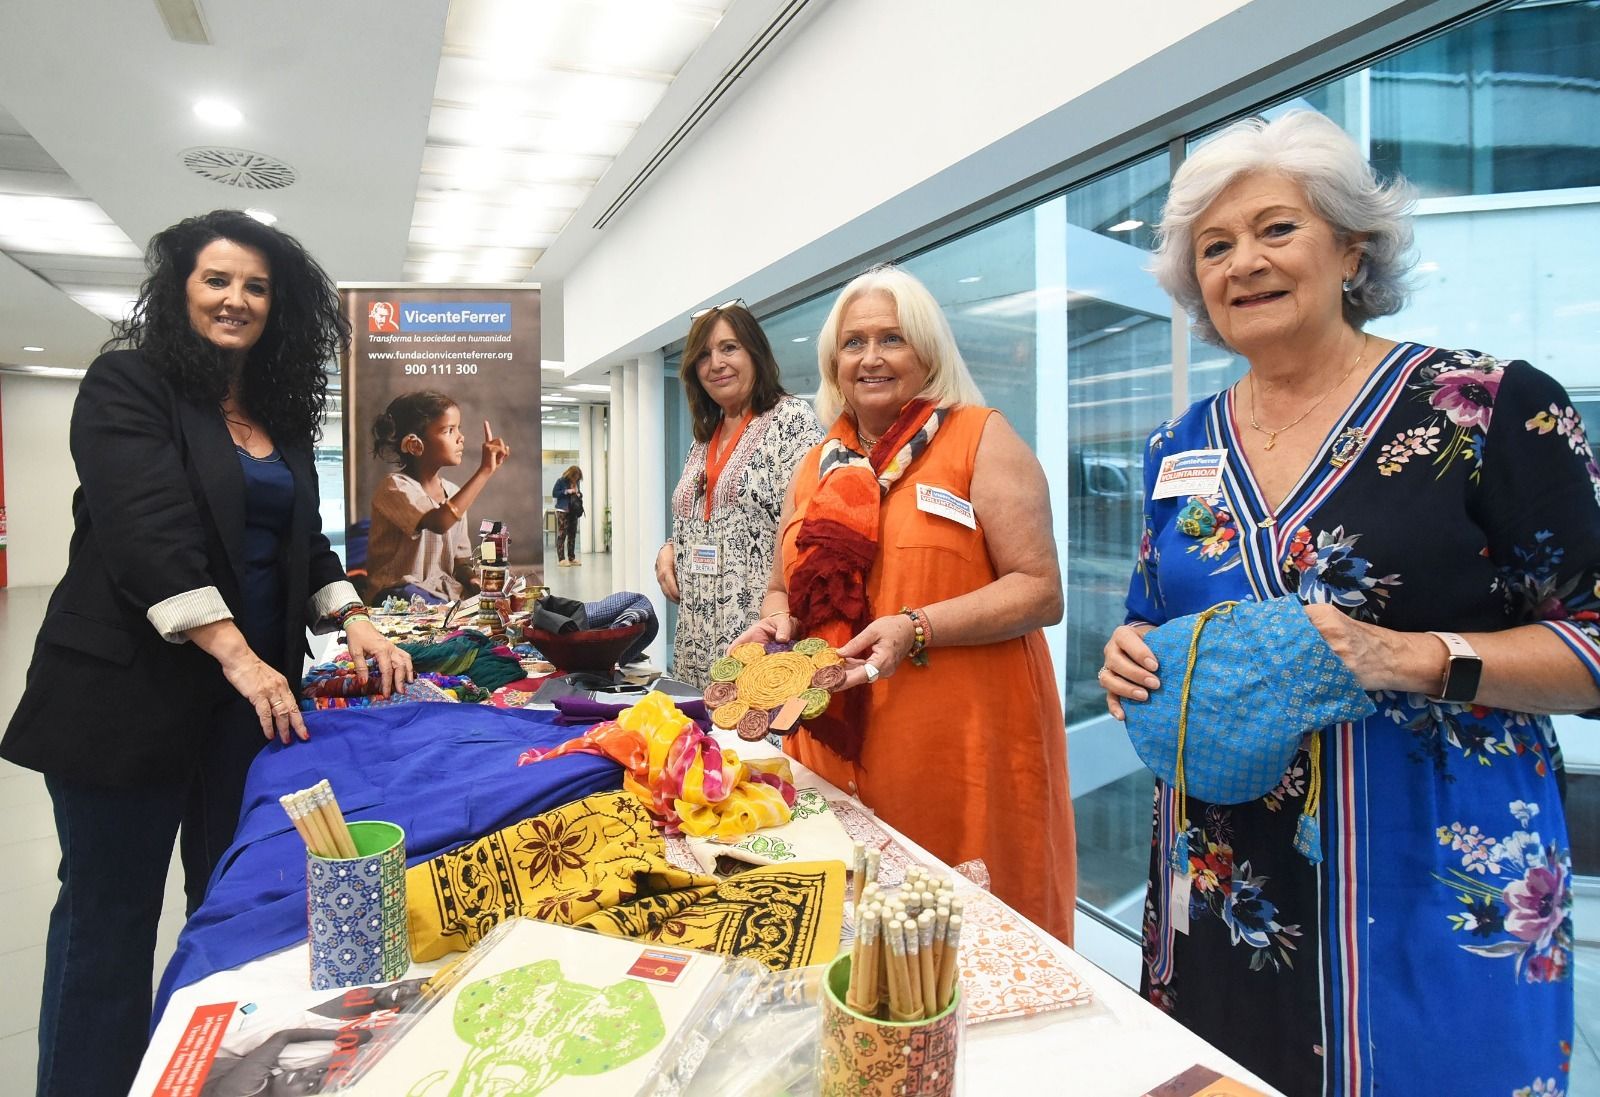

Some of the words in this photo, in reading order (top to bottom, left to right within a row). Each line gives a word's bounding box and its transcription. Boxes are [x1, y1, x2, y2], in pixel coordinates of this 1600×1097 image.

[404, 310, 506, 324] VicenteFerrer
[368, 334, 412, 343] Transforma
[413, 334, 421, 342] la
[422, 334, 456, 342] sociedad
[468, 334, 512, 342] humanidad
[368, 350, 513, 361] www.fundacionvicenteferrer.org
[404, 364, 427, 375] 900
[430, 364, 451, 375] 111
[455, 364, 478, 375] 300
[1161, 468, 1216, 481] VOLUNTARIO/A
